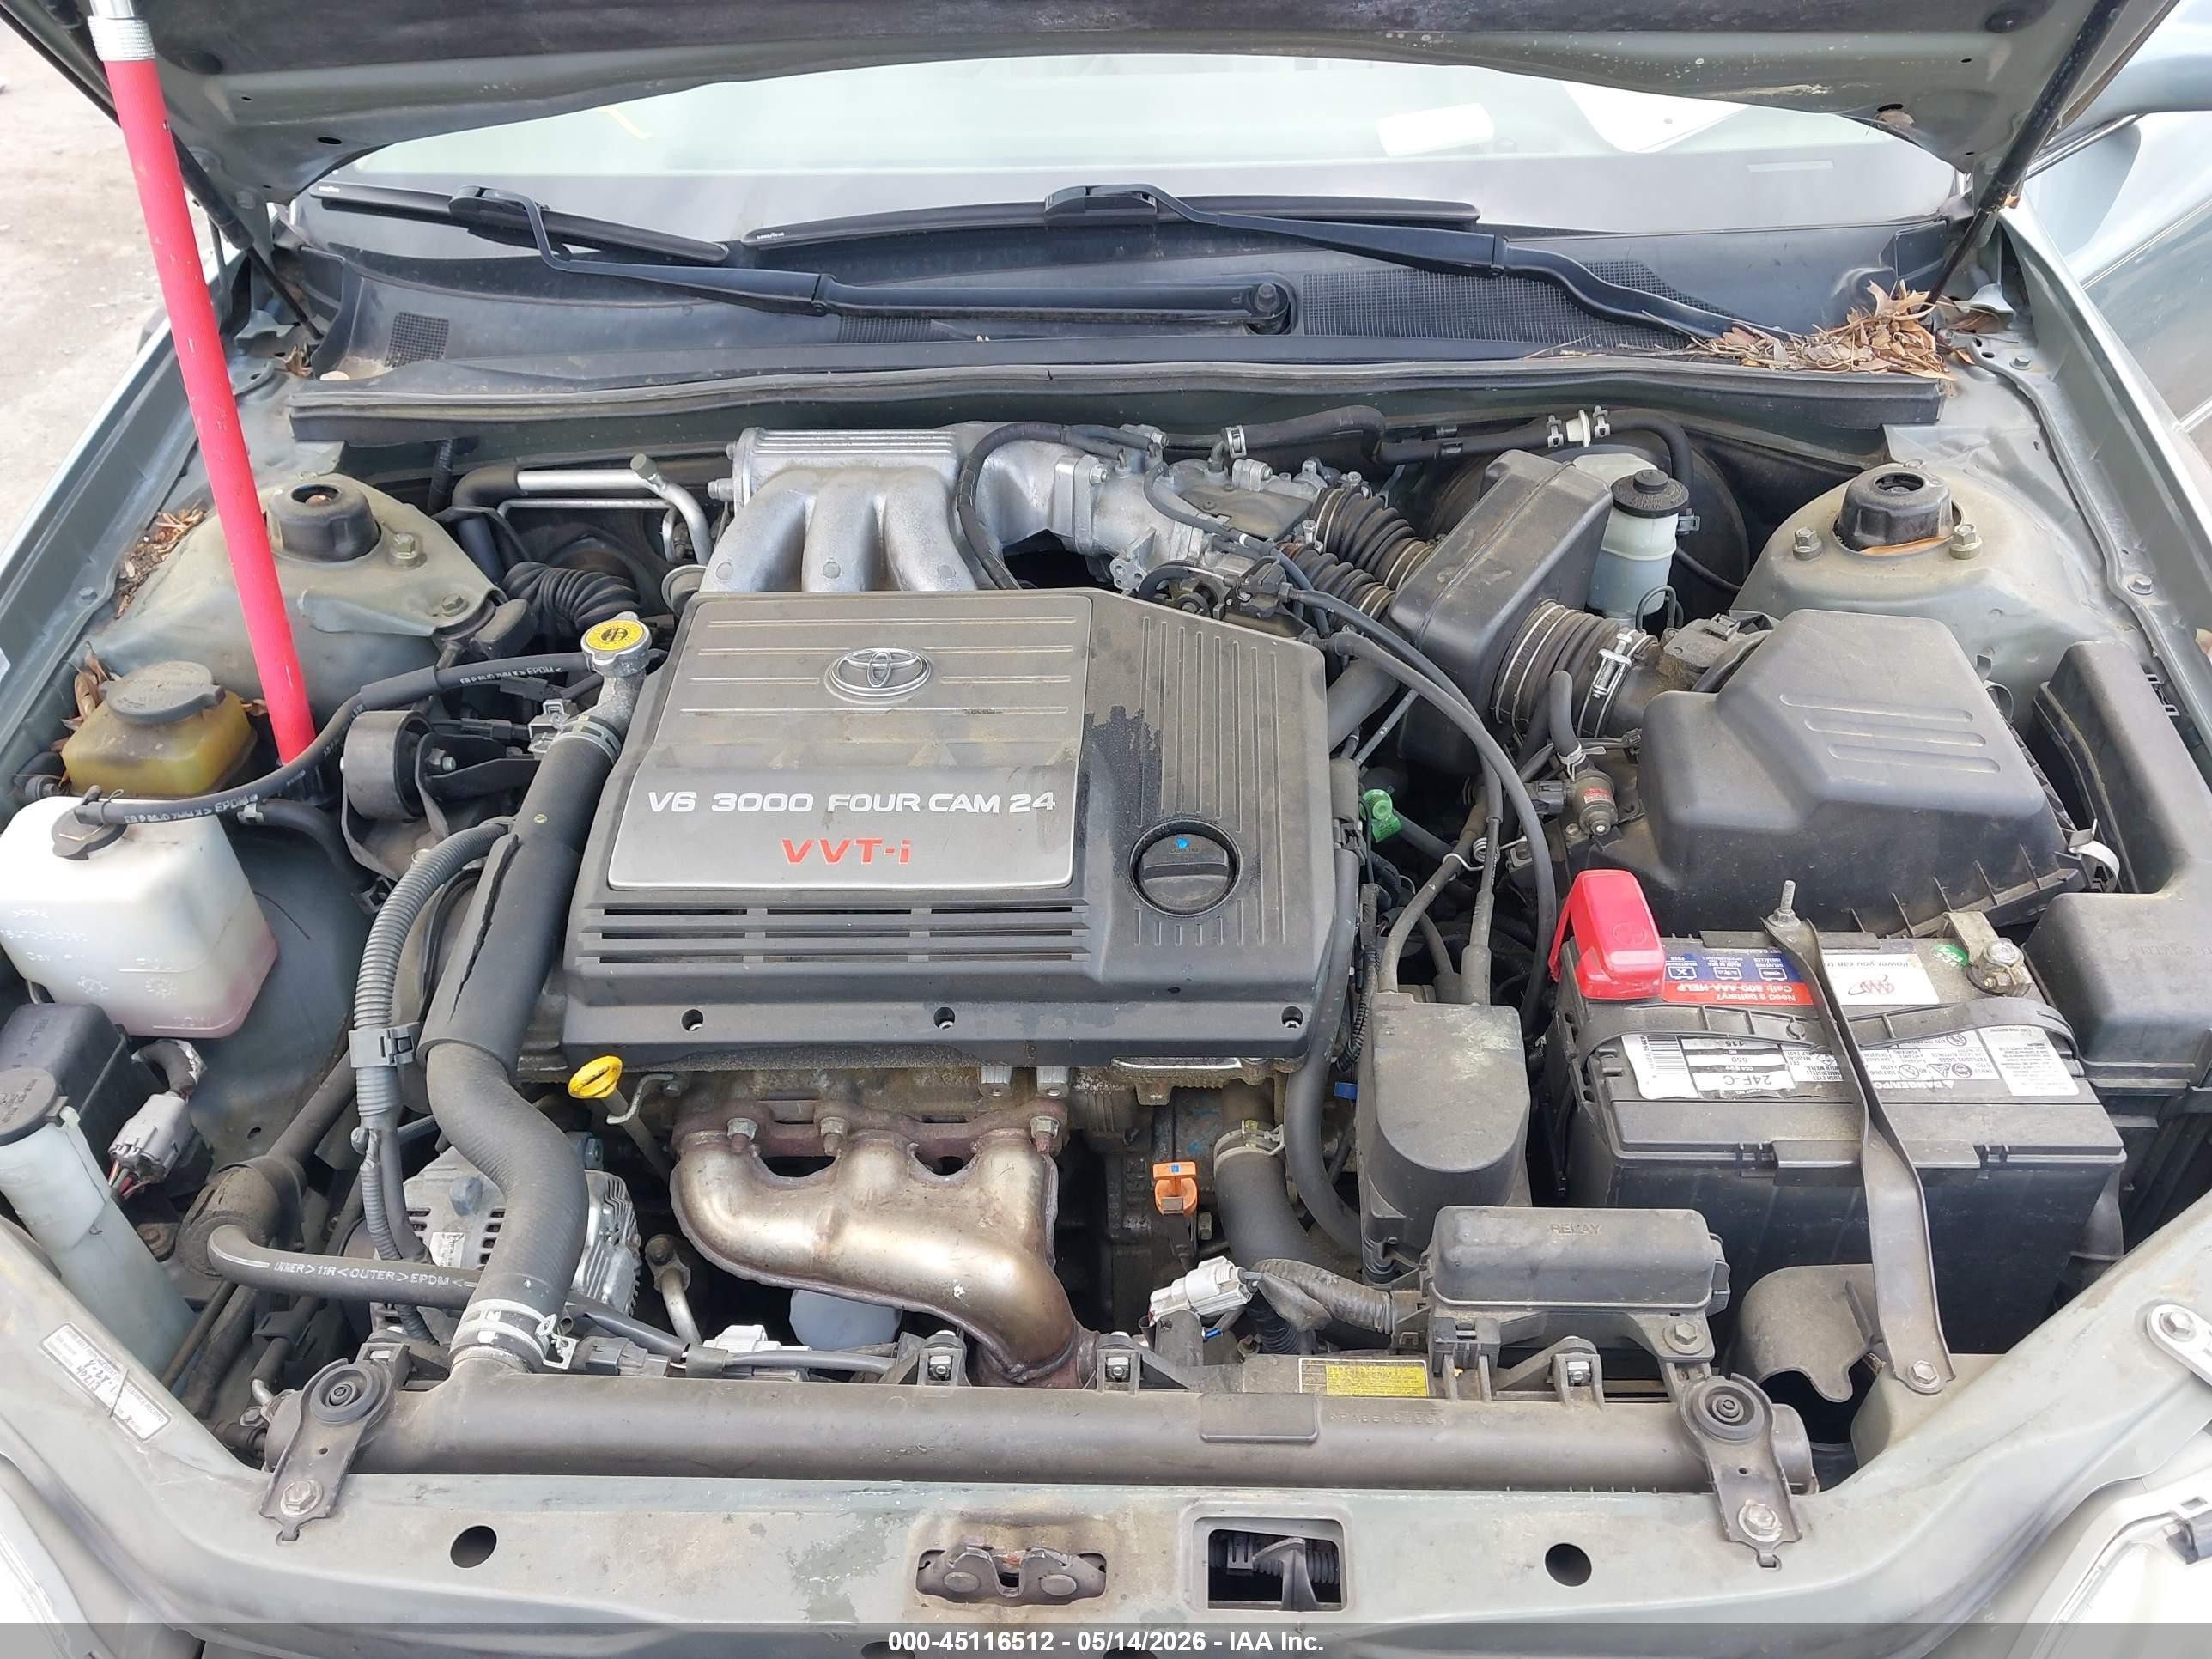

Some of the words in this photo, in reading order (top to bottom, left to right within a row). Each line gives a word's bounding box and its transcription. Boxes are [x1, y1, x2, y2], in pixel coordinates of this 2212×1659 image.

[648, 791, 698, 812] V6
[711, 793, 813, 812] 3000
[827, 793, 921, 812] FOUR
[928, 793, 1000, 813] CAM
[1008, 791, 1056, 811] 24
[780, 837, 912, 865] VVT-i
[1769, 993, 1796, 1001] Need
[1724, 1074, 1772, 1085] 24F-C
[1551, 1222, 1601, 1236] RELAY
